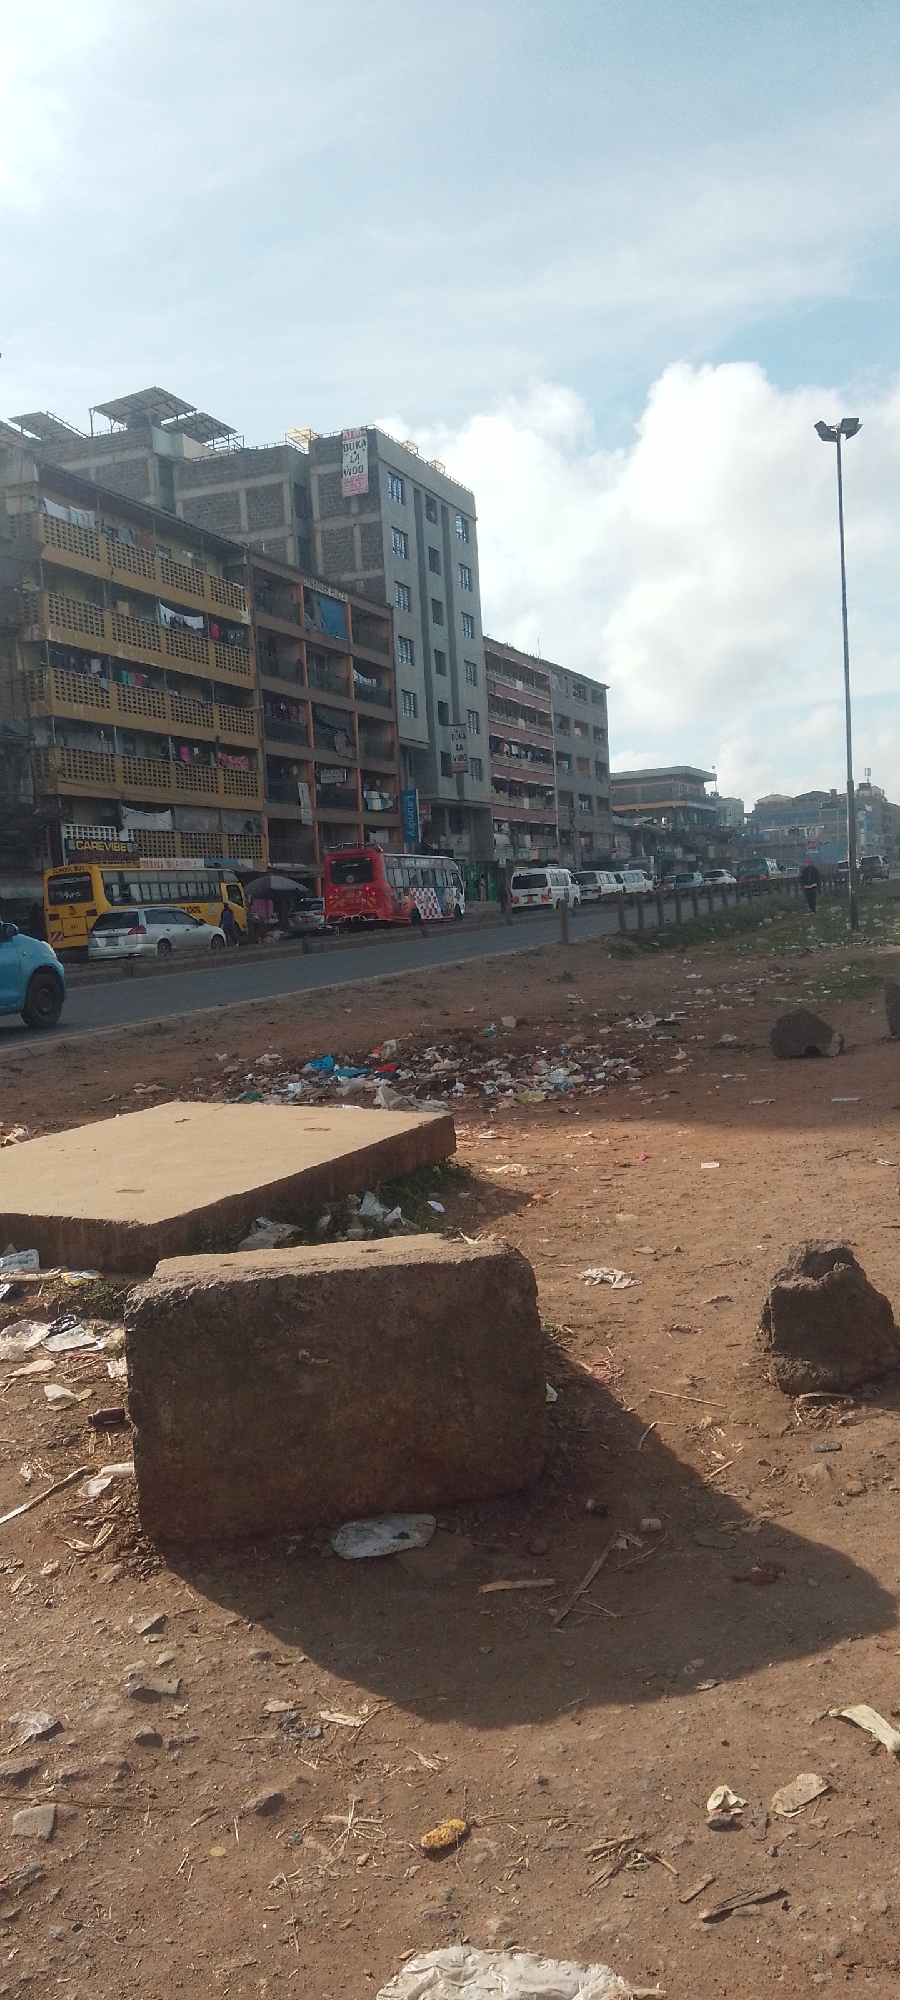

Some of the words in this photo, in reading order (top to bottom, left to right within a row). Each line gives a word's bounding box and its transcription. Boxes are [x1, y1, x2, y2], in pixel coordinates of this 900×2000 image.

[343, 438, 367, 453] DUKA
[350, 453, 360, 464] LA
[456, 743, 464, 752] LA
[406, 795, 415, 837] Laundry
[75, 840, 127, 852] CAREVIBE
[52, 866, 73, 875] SCHOOL
